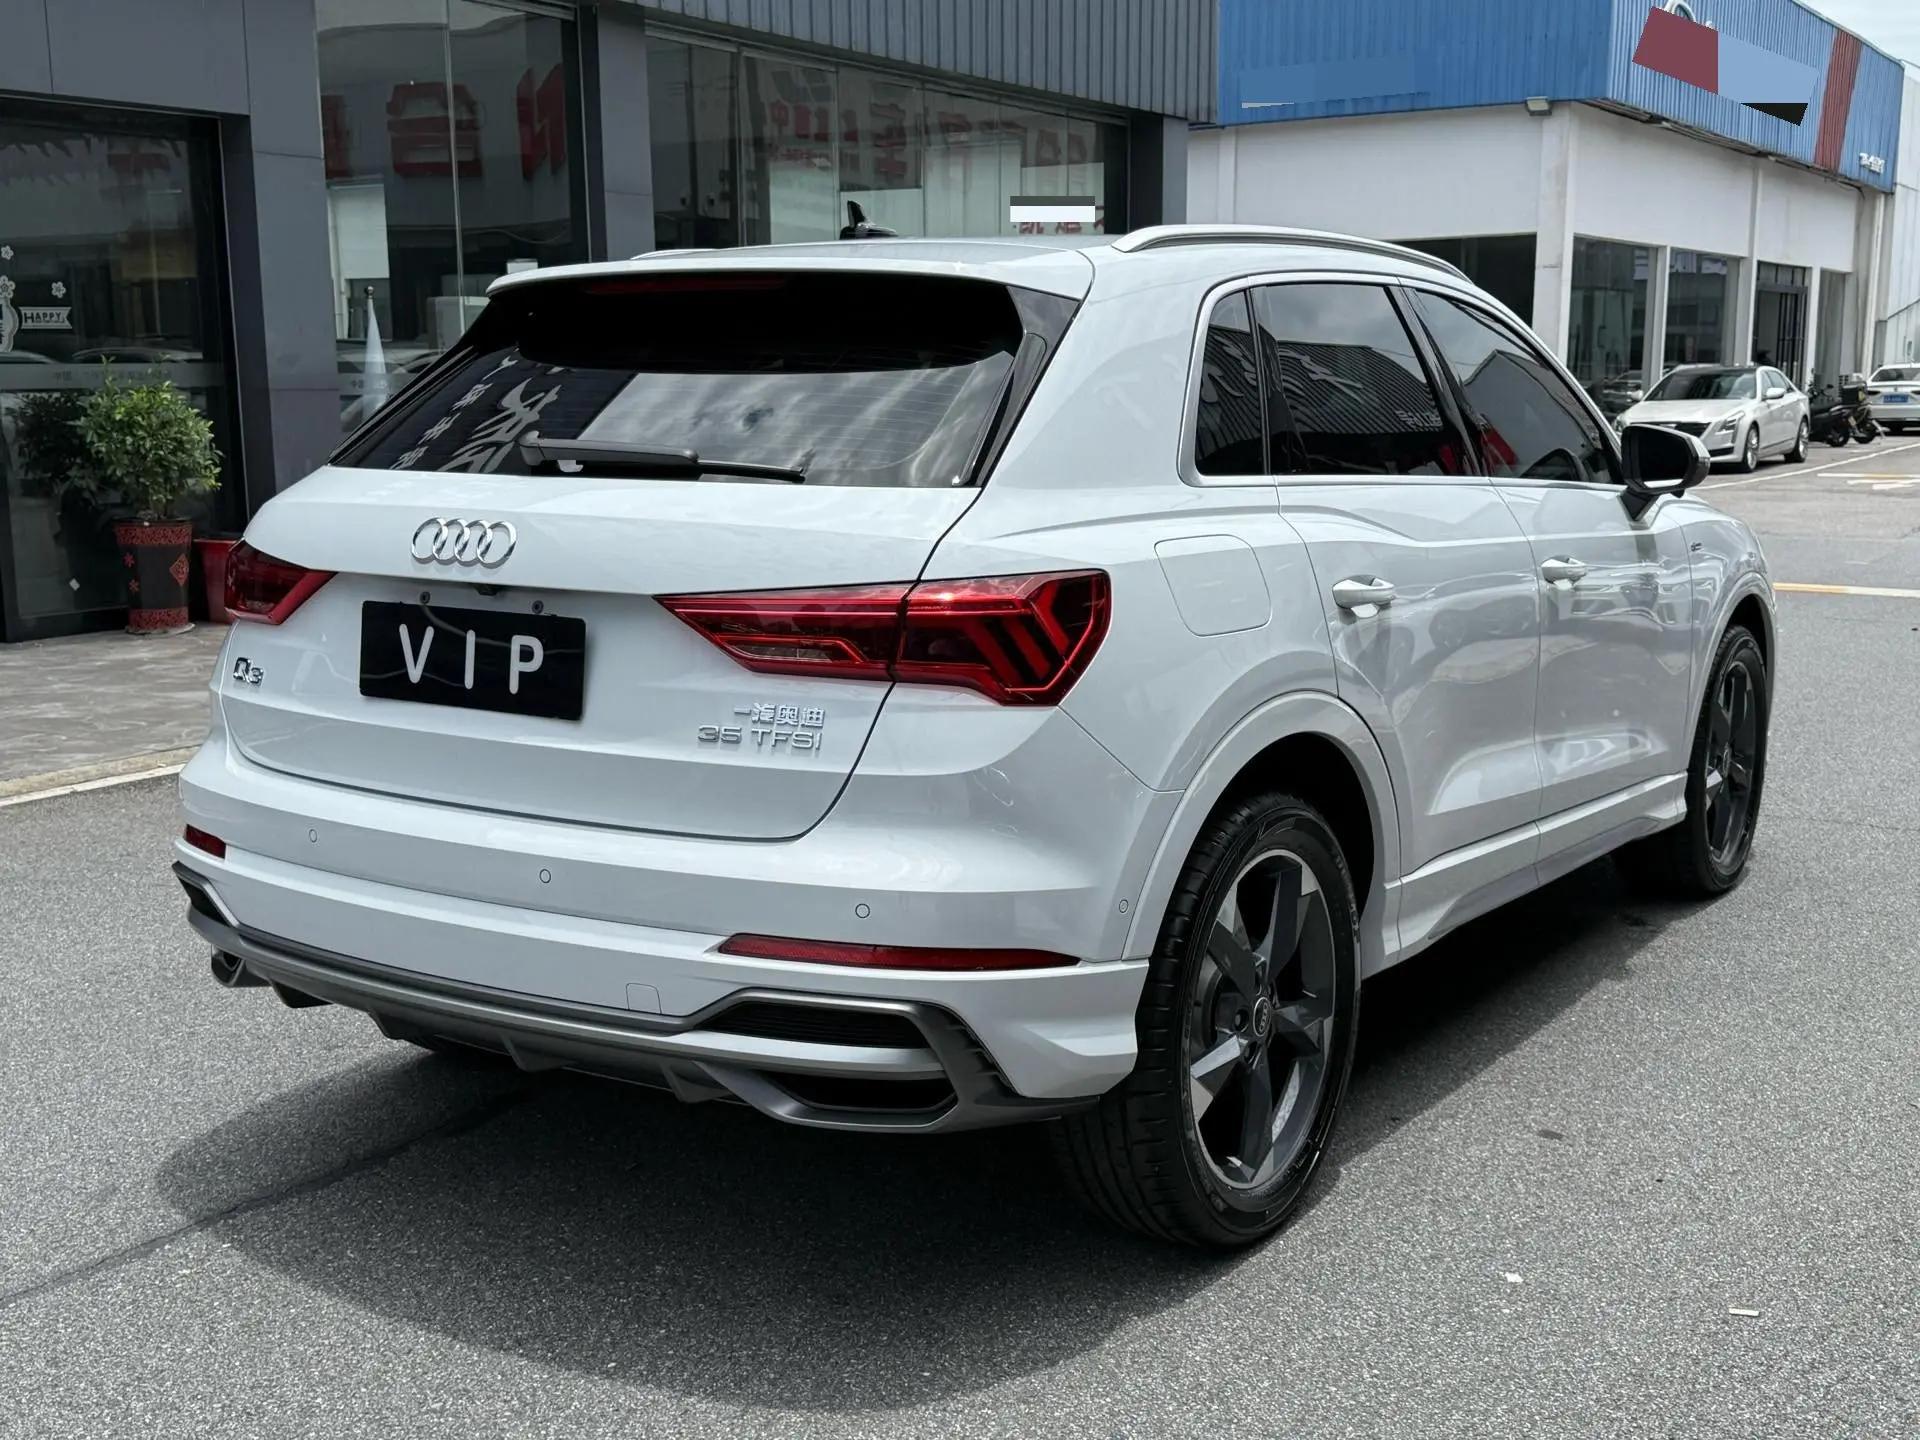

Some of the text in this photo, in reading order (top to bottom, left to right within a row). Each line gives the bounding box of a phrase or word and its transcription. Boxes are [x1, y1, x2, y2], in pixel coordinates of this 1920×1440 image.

[24, 312, 62, 323] HAPPY
[232, 656, 264, 687] Q3
[399, 623, 545, 695] VIP
[733, 702, 825, 728] 一汽奥迪
[697, 724, 822, 751] 35 TFSI
